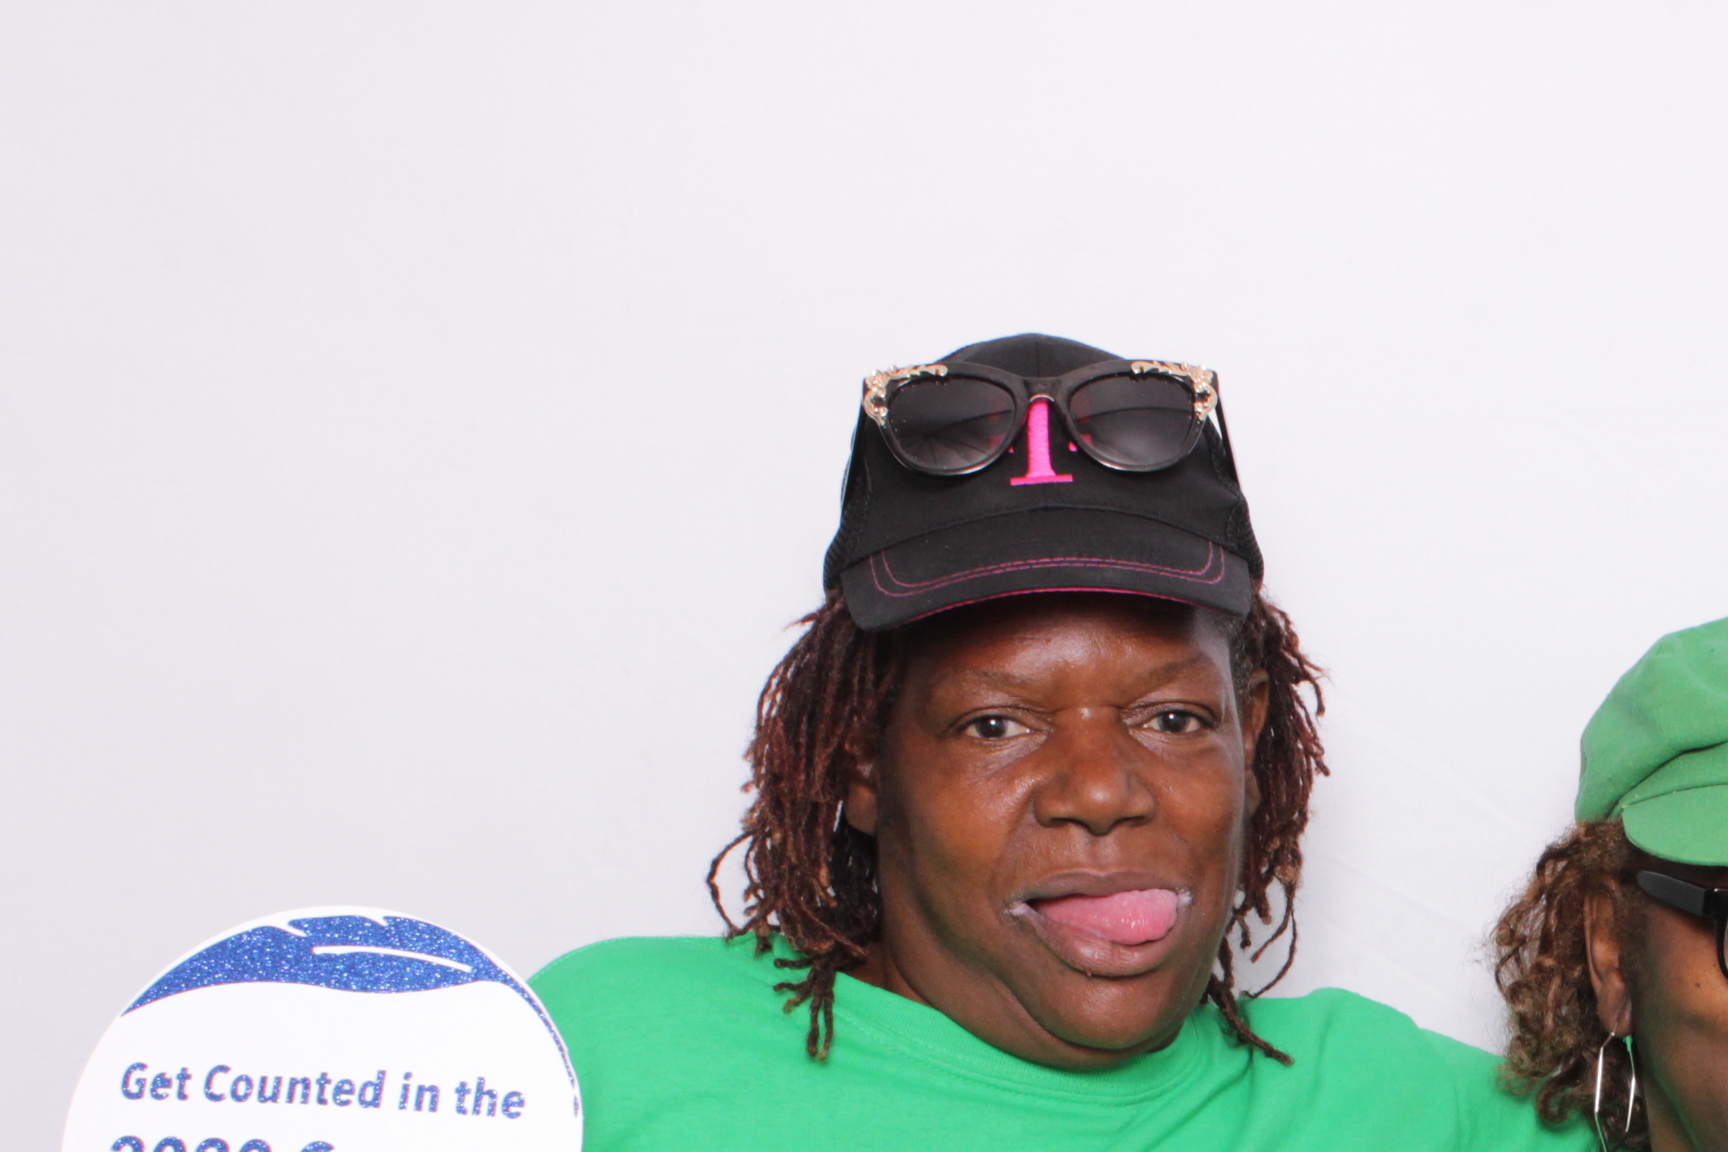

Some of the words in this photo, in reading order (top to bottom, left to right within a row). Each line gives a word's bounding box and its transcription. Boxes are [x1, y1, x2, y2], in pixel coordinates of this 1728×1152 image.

[121, 1062, 193, 1101] Get
[203, 1064, 386, 1109] Counted
[398, 1071, 440, 1113] in
[454, 1077, 526, 1119] the
